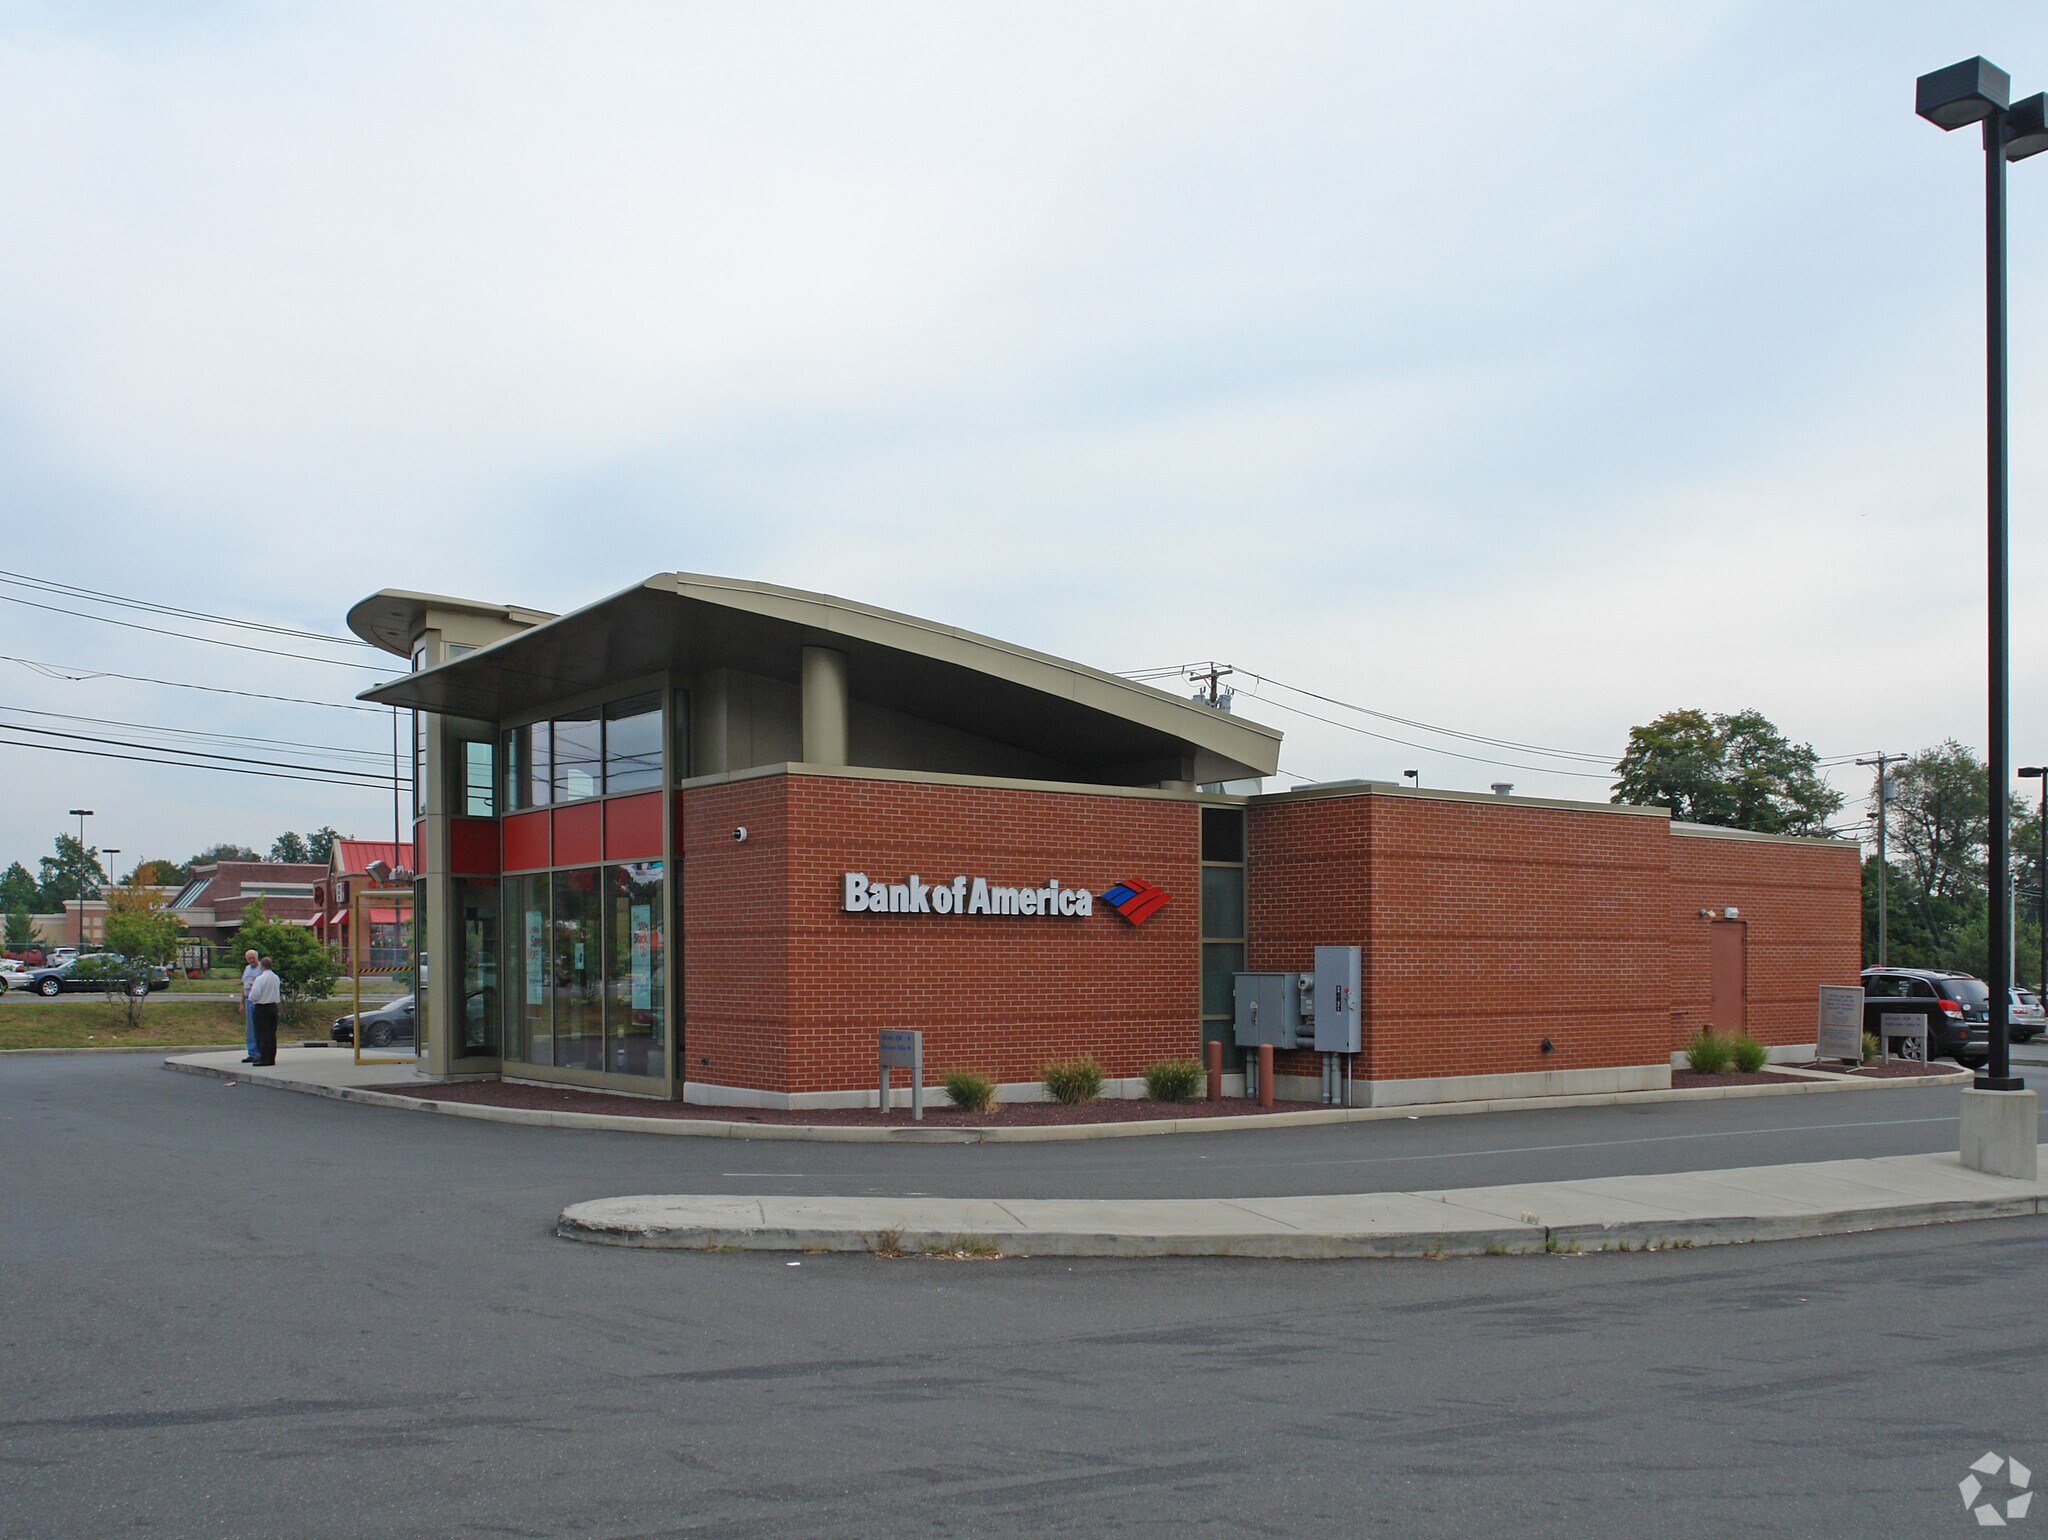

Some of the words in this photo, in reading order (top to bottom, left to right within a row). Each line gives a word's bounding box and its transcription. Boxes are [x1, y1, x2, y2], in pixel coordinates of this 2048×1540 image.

[844, 872, 930, 913] Bank
[931, 875, 967, 914] of
[967, 877, 1093, 916] America
